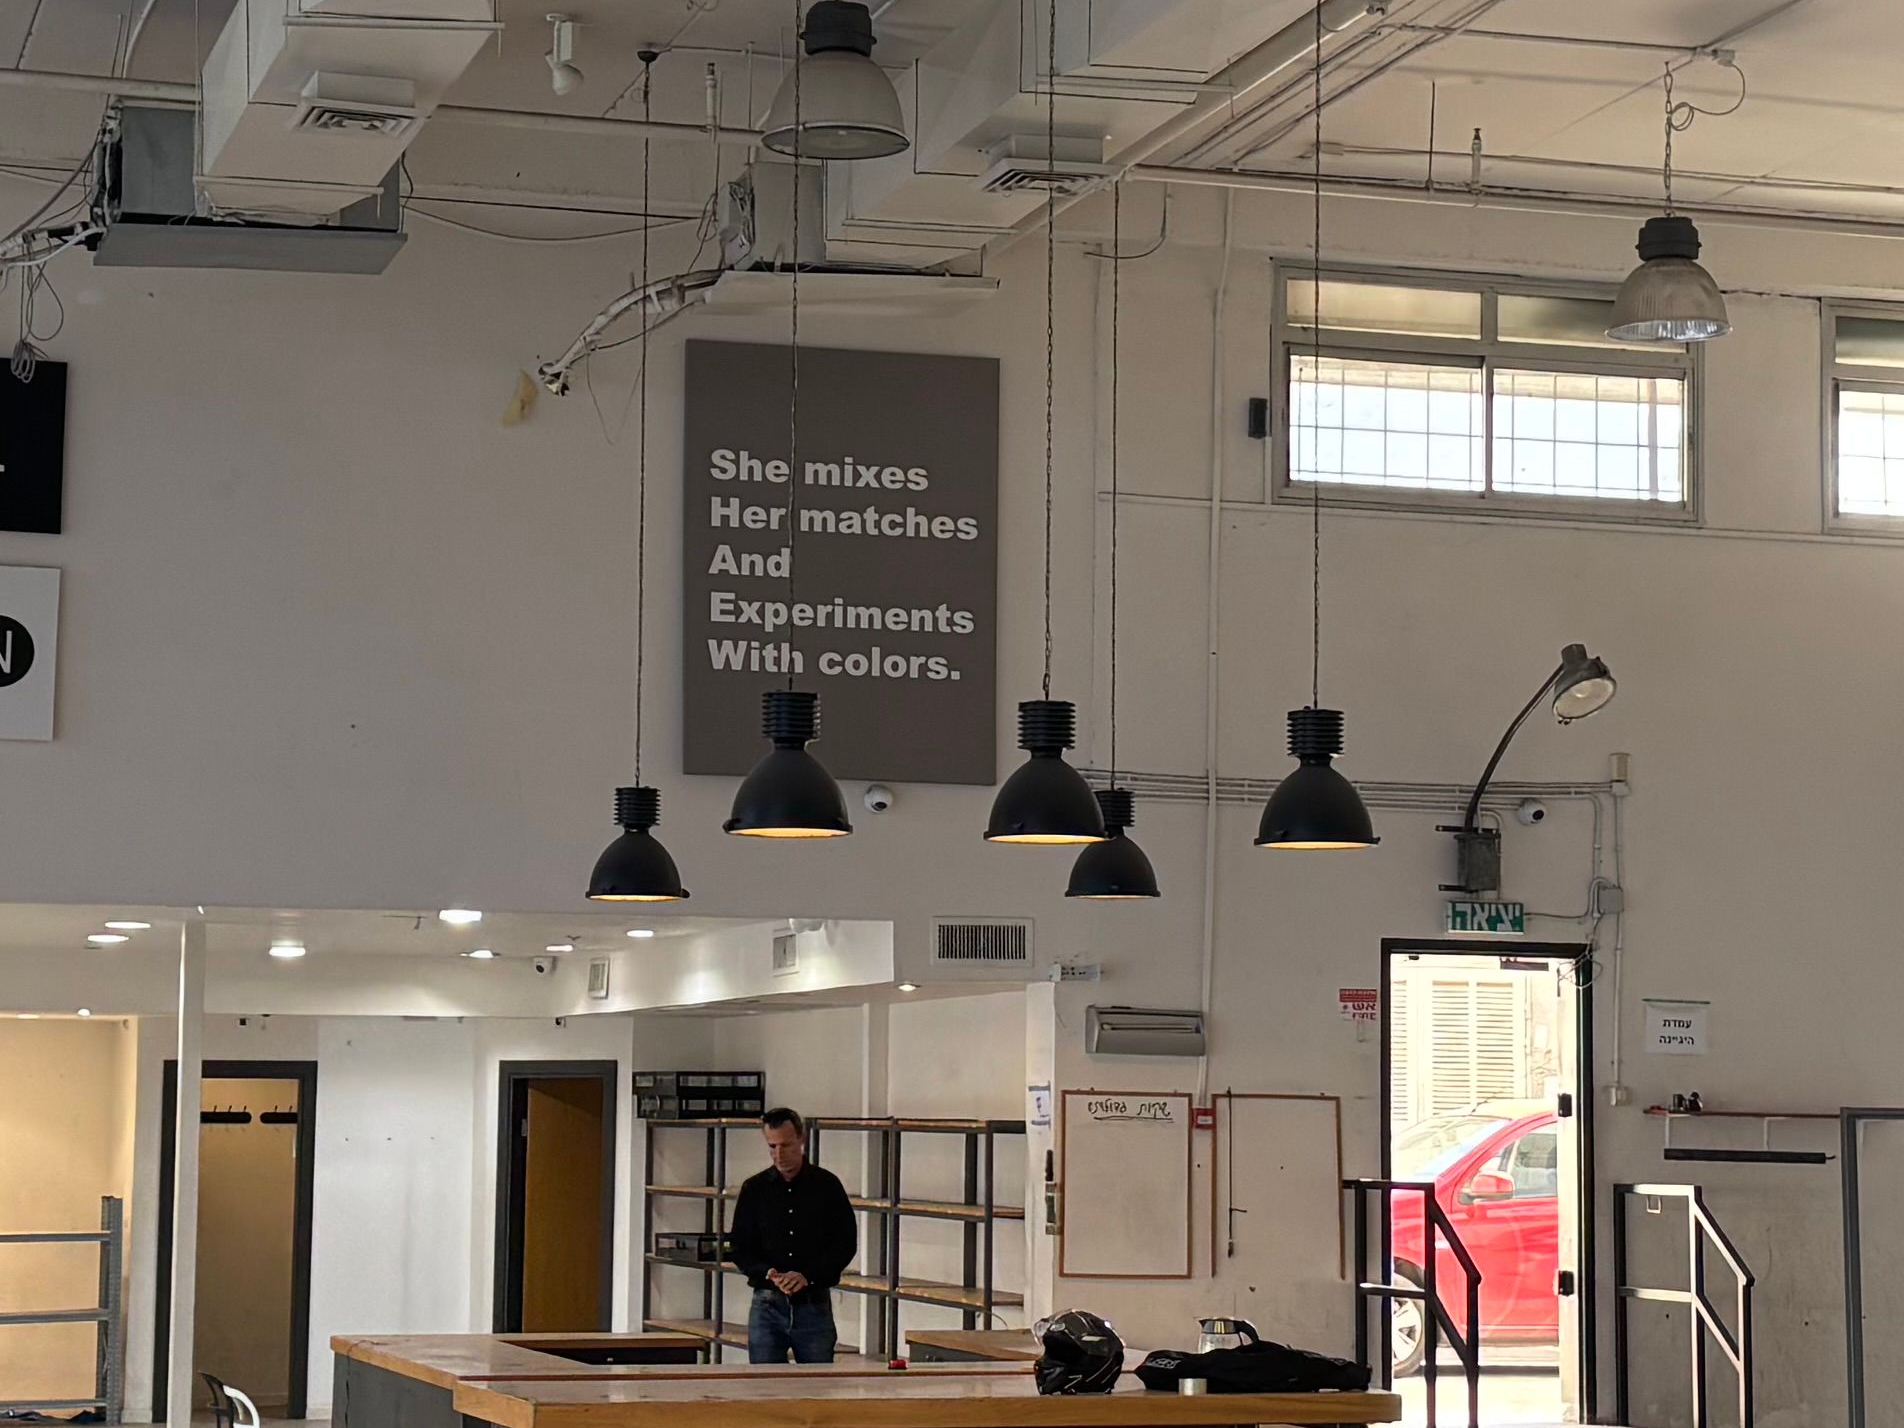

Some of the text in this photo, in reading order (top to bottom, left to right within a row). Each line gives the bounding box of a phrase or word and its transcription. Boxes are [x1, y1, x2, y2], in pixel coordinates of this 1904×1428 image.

[710, 449, 928, 490] She mixes
[711, 497, 978, 540] Her matches
[708, 545, 790, 577] And
[711, 592, 973, 633] Experiments
[708, 640, 960, 679] With colors.
[1455, 903, 1521, 932] יציאה
[1352, 1003, 1376, 1011] אש
[1663, 1019, 1692, 1028] עמדת
[1660, 1036, 1695, 1045] היגיינה
